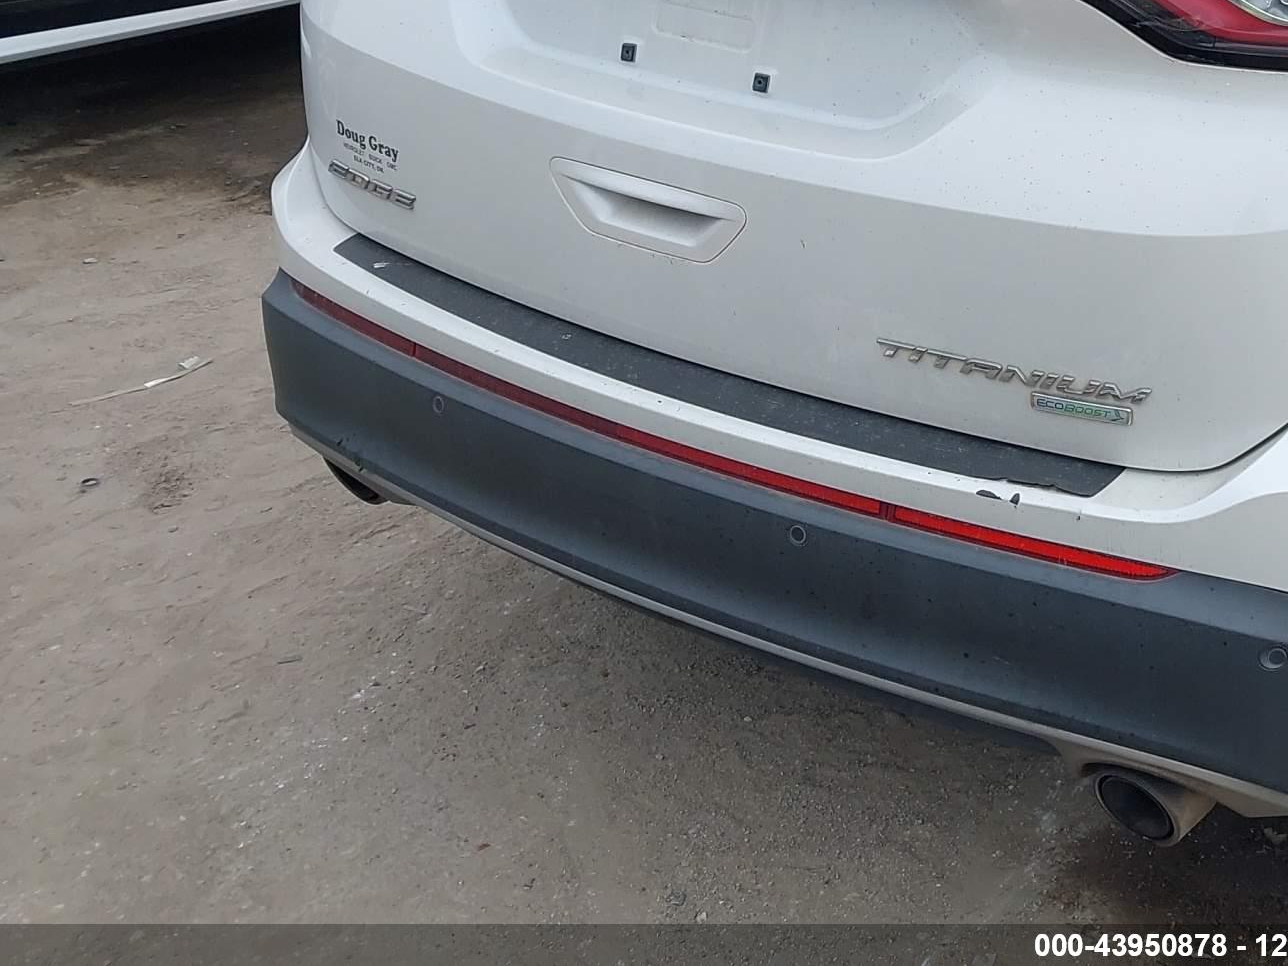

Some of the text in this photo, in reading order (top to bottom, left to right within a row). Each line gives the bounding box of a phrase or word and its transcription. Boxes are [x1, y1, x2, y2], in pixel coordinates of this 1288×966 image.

[336, 118, 399, 163] Doug Gray
[328, 159, 416, 210] EDGE
[877, 337, 1153, 405] TITANIUM
[1035, 397, 1112, 420] ECOBOOST
